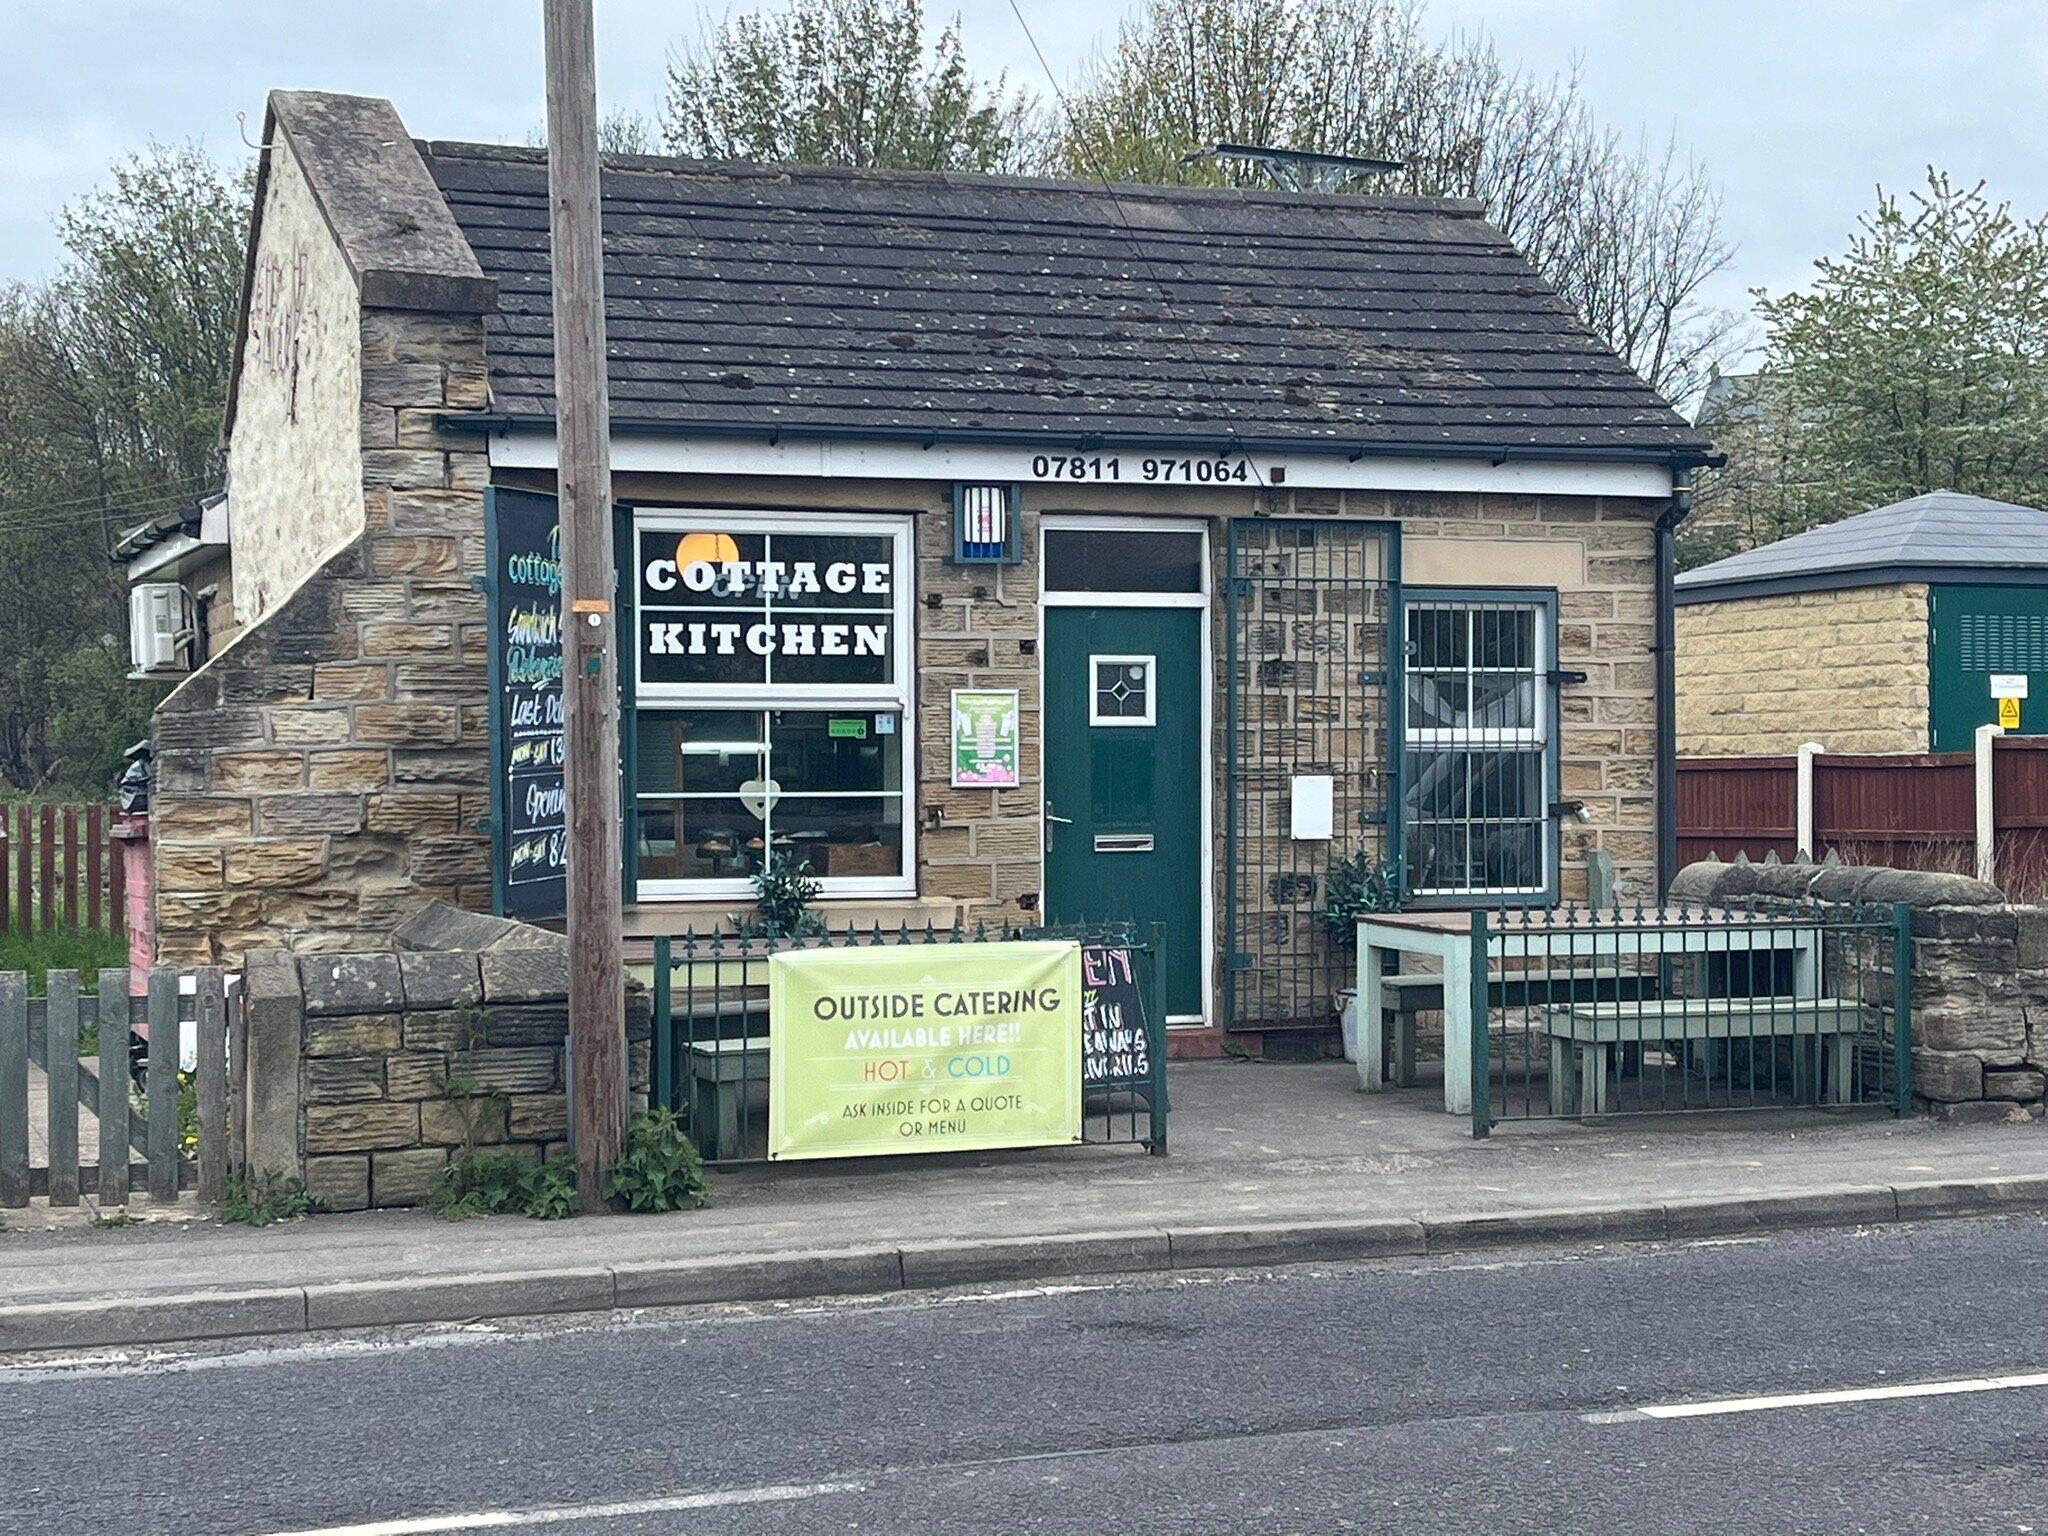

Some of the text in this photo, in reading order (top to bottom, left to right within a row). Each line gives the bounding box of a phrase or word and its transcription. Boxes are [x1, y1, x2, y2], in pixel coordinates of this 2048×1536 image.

[1032, 455, 1248, 482] 07811 971064
[645, 559, 890, 594] COTTAGE
[649, 622, 888, 656] KITCHEN
[511, 694, 543, 727] Last
[526, 781, 566, 824] Openin
[813, 993, 924, 1021] OUTSIDE
[934, 988, 1061, 1017] CATERING
[844, 1022, 1021, 1051] AVAILABLE HERE!!
[864, 1054, 1011, 1082] HOT & COLD
[842, 1094, 1022, 1118] ASK INSIDE FOR A QUOTE
[899, 1118, 966, 1137] OR MENU
